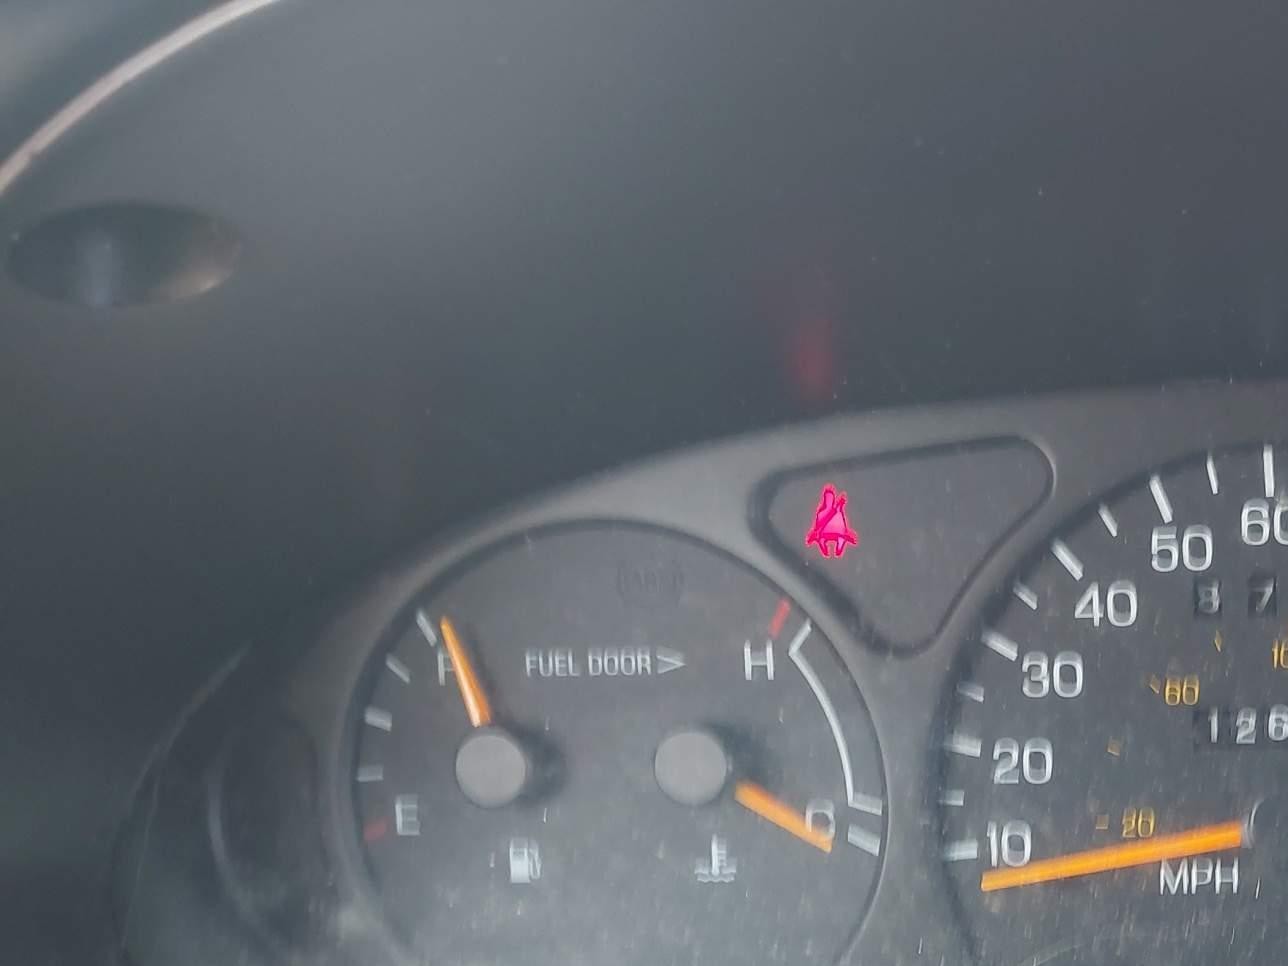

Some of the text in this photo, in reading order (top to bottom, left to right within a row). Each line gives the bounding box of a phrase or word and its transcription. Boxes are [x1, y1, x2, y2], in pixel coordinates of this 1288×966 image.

[1151, 524, 1214, 572] 50
[1074, 578, 1138, 627] 40
[525, 648, 652, 677] FUEL DOOR
[743, 638, 775, 681] H
[1021, 650, 1084, 698] 30
[1164, 674, 1200, 706] 60
[992, 737, 1053, 784] 20
[394, 795, 420, 836] E
[1122, 807, 1156, 838] 20
[986, 820, 1032, 868] 10
[1159, 857, 1240, 895] MPH
